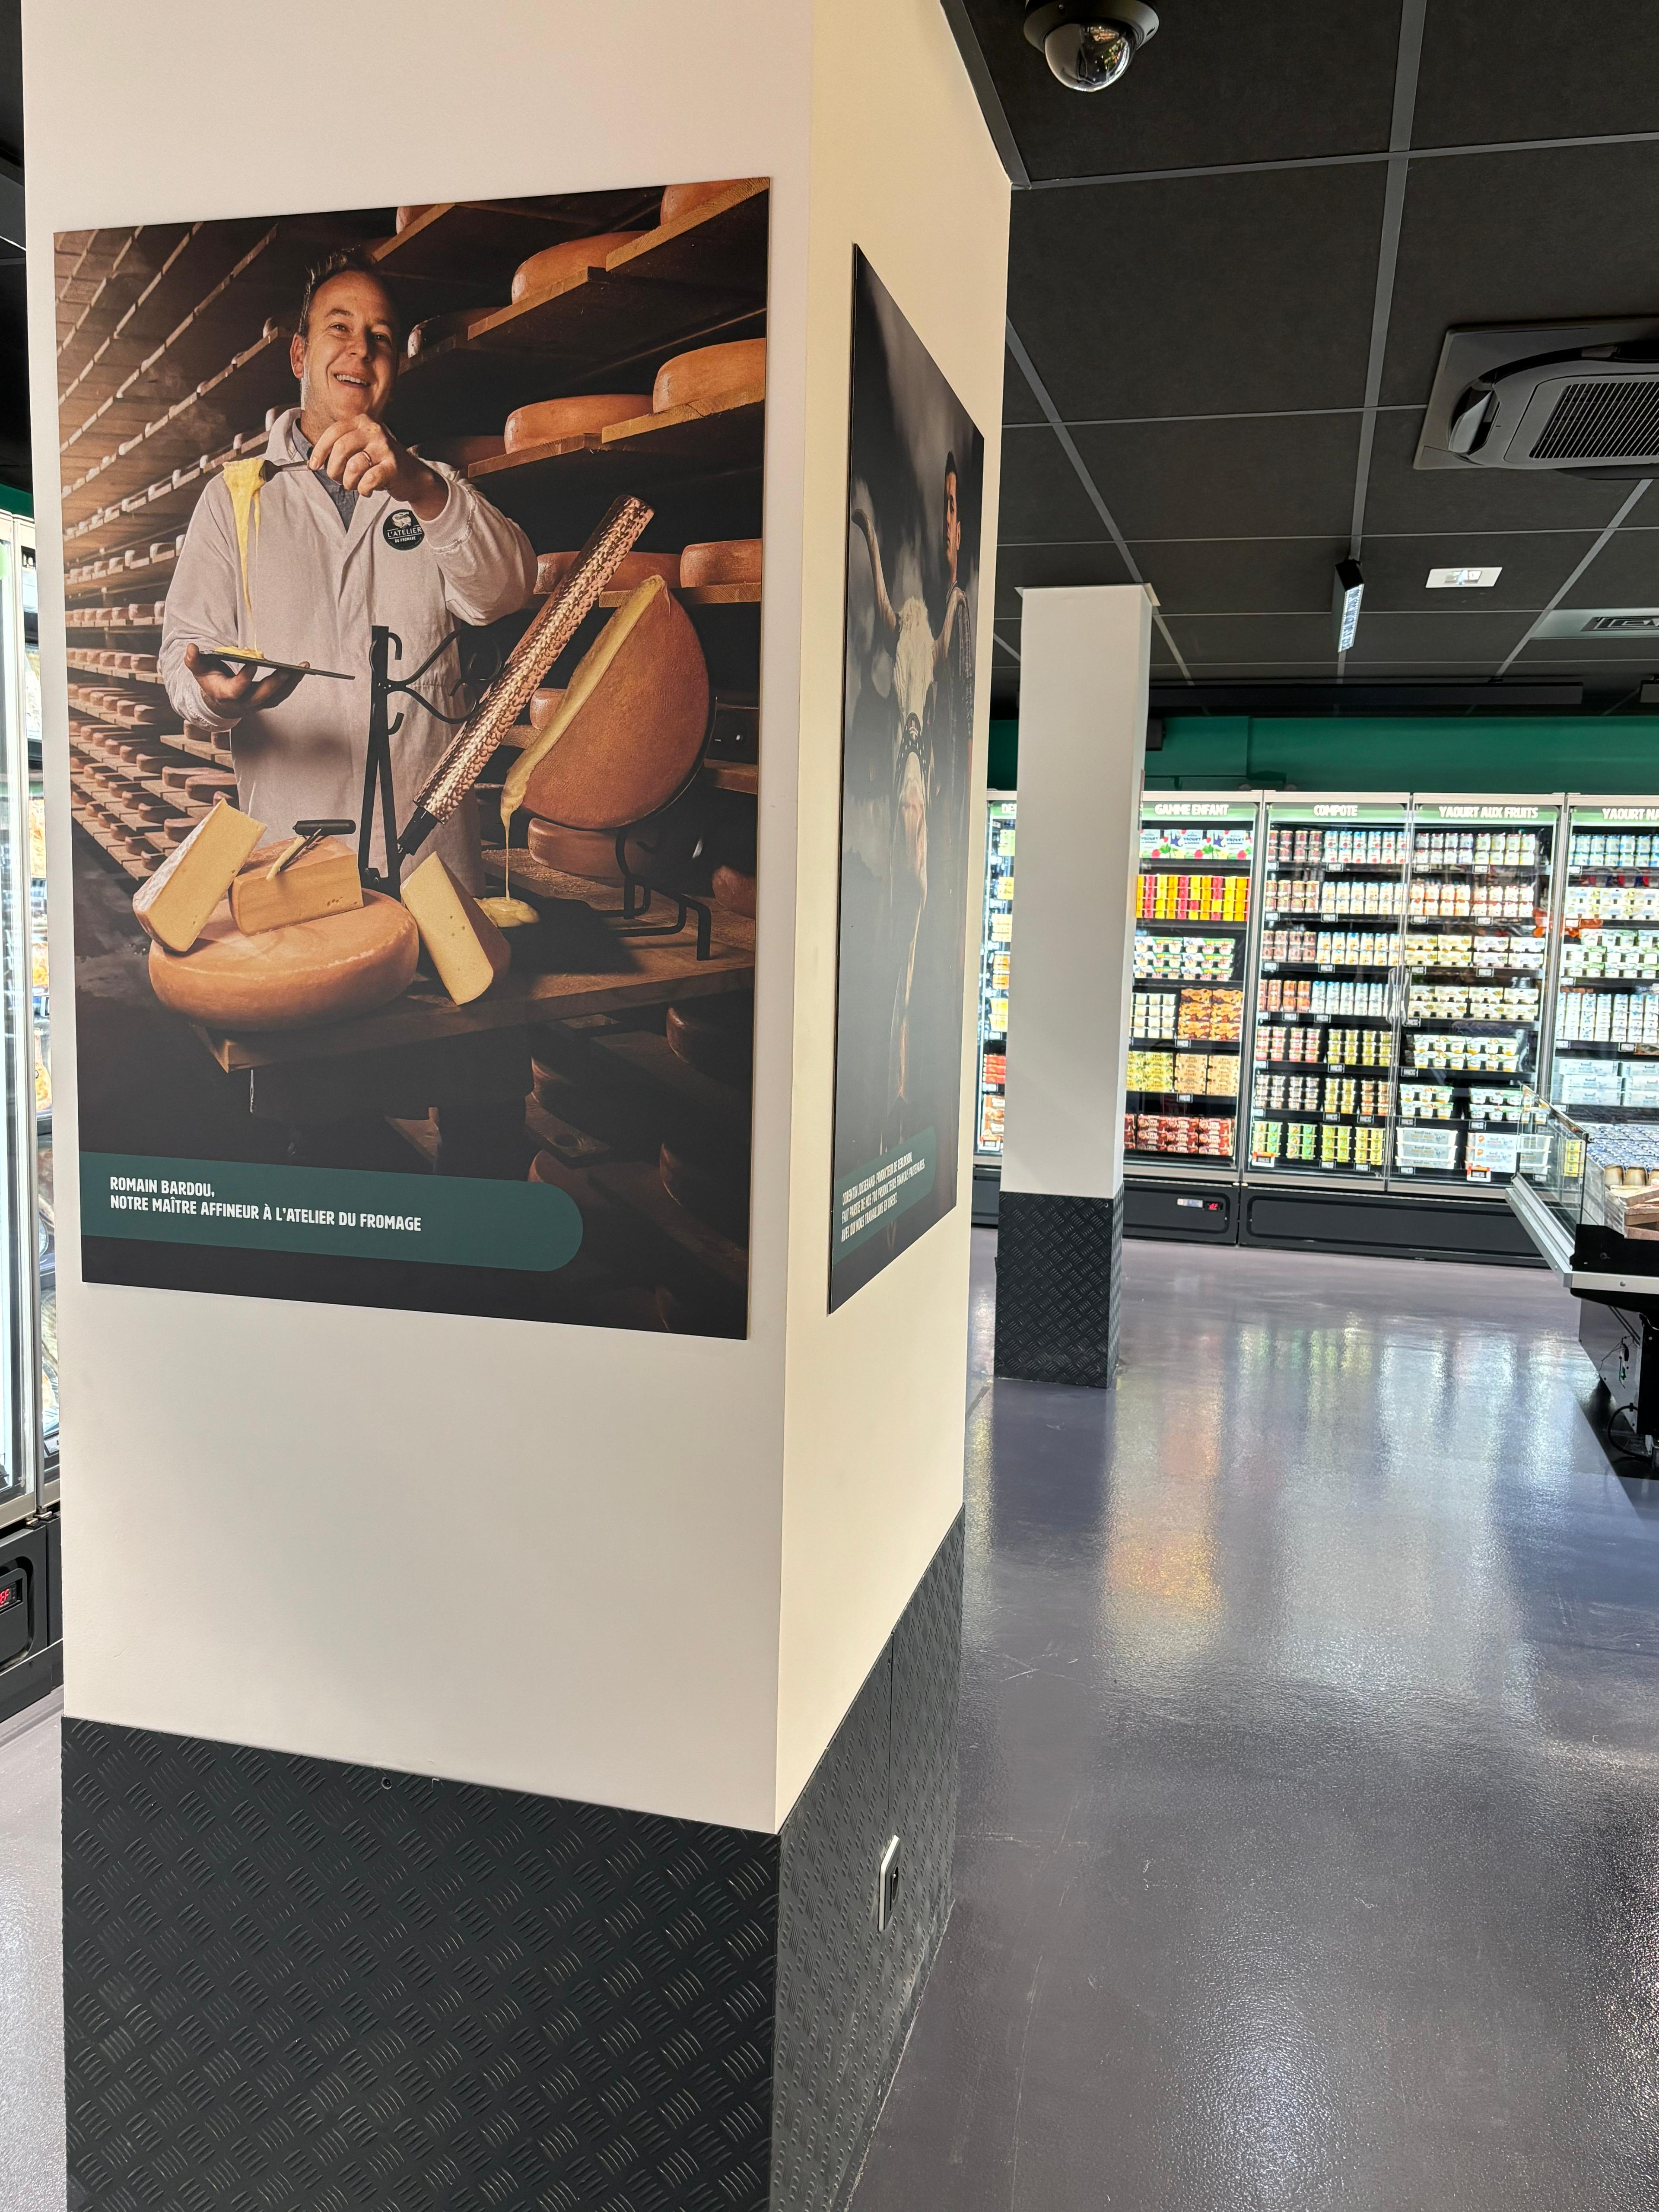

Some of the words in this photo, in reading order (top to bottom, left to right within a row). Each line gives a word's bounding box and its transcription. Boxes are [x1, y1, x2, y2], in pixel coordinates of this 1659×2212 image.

[387, 527, 422, 537] L'ATELIER
[1154, 804, 1191, 815] GAMME
[1192, 804, 1229, 815] ENFANT
[1313, 805, 1358, 816] COMPOTE
[1439, 806, 1479, 818] YAOURT
[1480, 807, 1503, 818] AUX
[1504, 807, 1538, 818] FRUITS
[1602, 808, 1645, 820] YAOURT
[110, 1176, 157, 1193] ROMAIN
[161, 1180, 215, 1198] BARDOU,
[110, 1195, 149, 1211] NOTRE
[152, 1196, 197, 1214] MAÎTRE
[200, 1201, 259, 1220] AFFINEUR
[263, 1203, 272, 1220] À
[276, 1207, 335, 1225] L'ATELIER
[339, 1212, 356, 1227] DU
[360, 1213, 421, 1231] FROMAGE
[856, 1214, 864, 1232] NOUS
